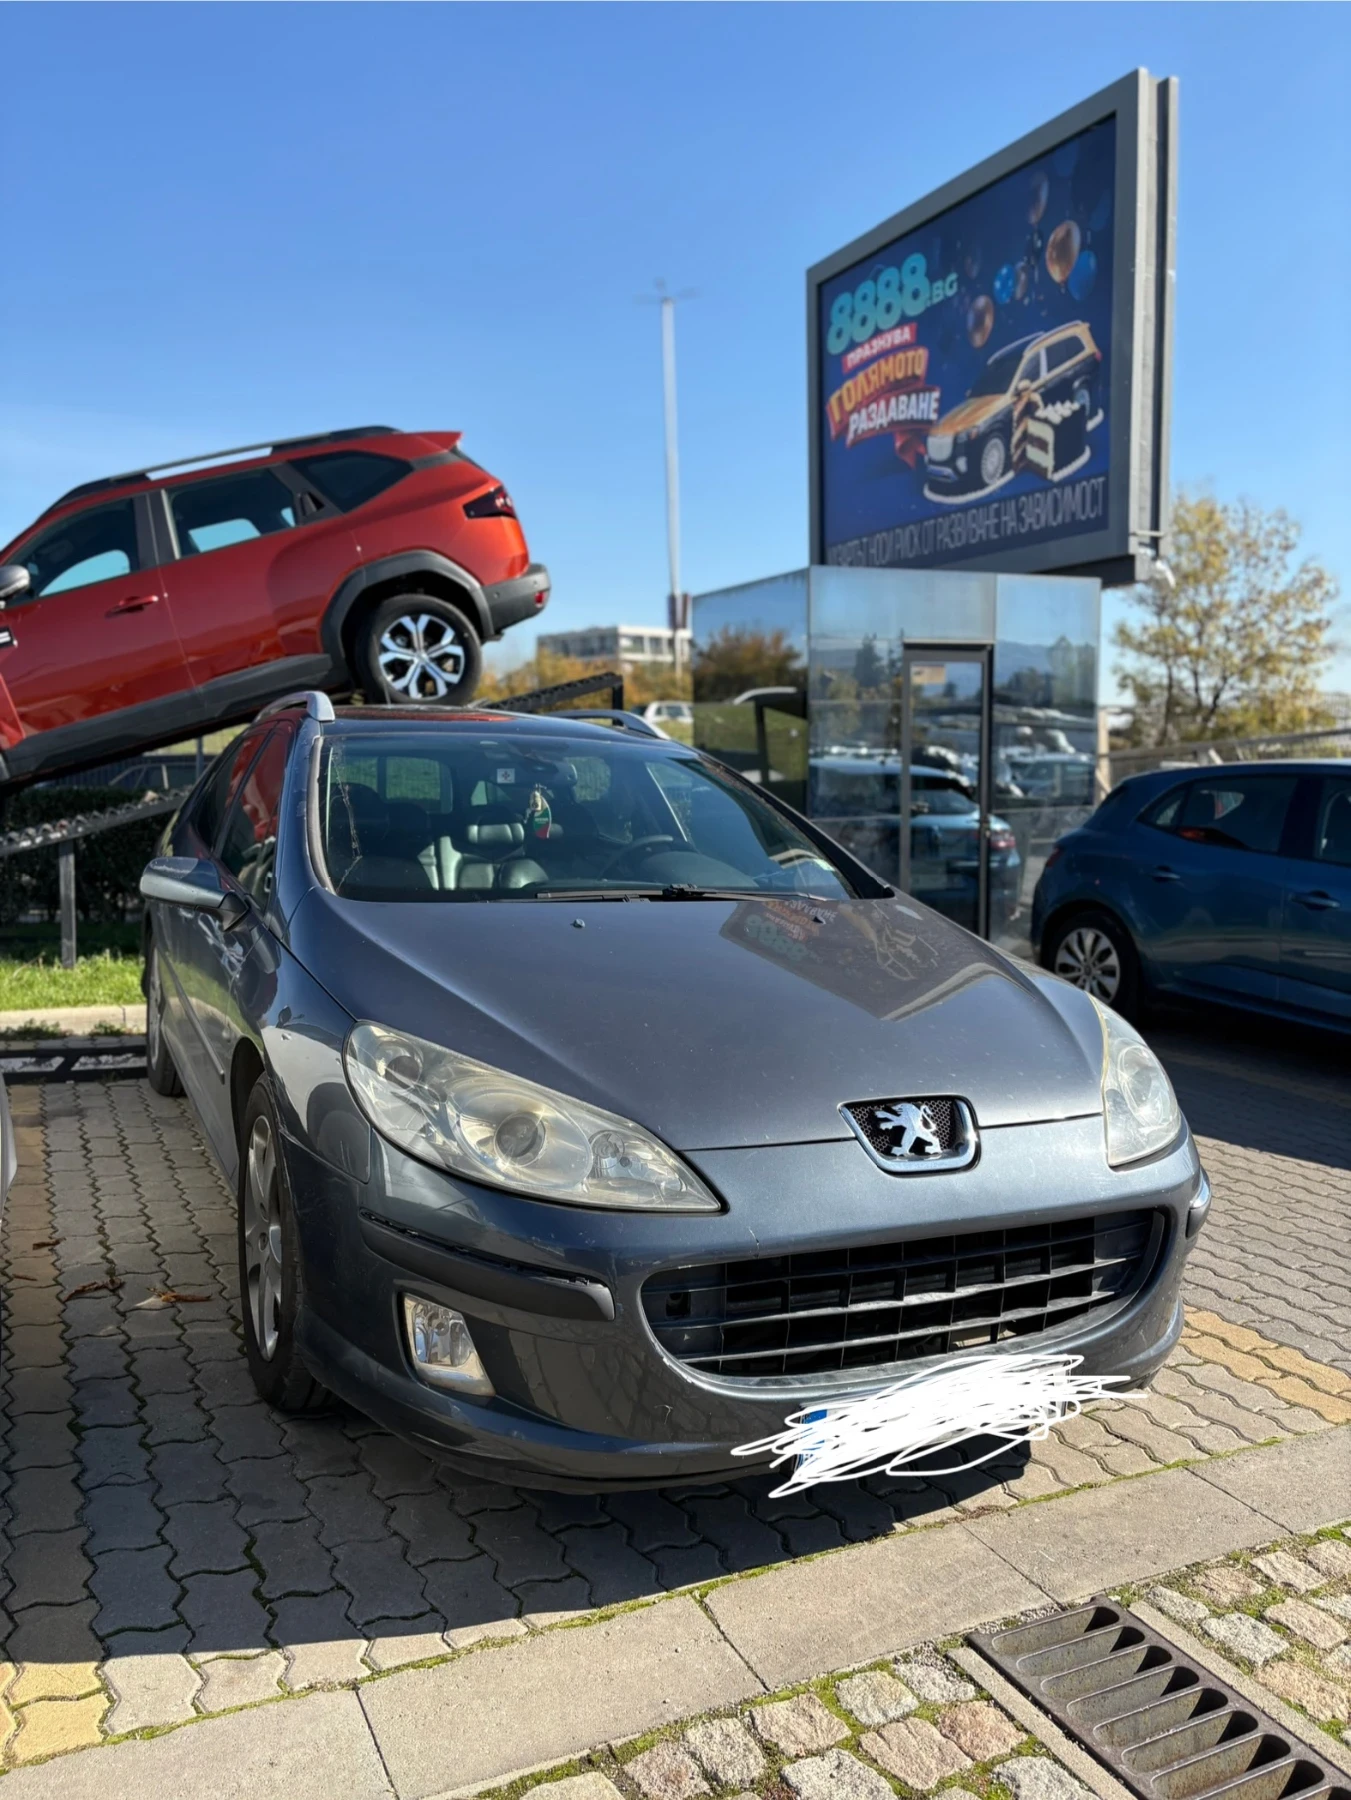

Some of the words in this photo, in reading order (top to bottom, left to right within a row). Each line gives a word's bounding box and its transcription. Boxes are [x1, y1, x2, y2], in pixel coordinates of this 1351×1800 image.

[827, 253, 958, 355] 8888.BG
[847, 326, 911, 367] ПРАЗНУВА
[829, 348, 926, 423] ГОЛЯМОТО
[849, 391, 939, 437] РАЗДАВАНЕ
[1001, 500, 1018, 537] НА
[1018, 477, 1106, 534] ЗАВИСИМОСТ
